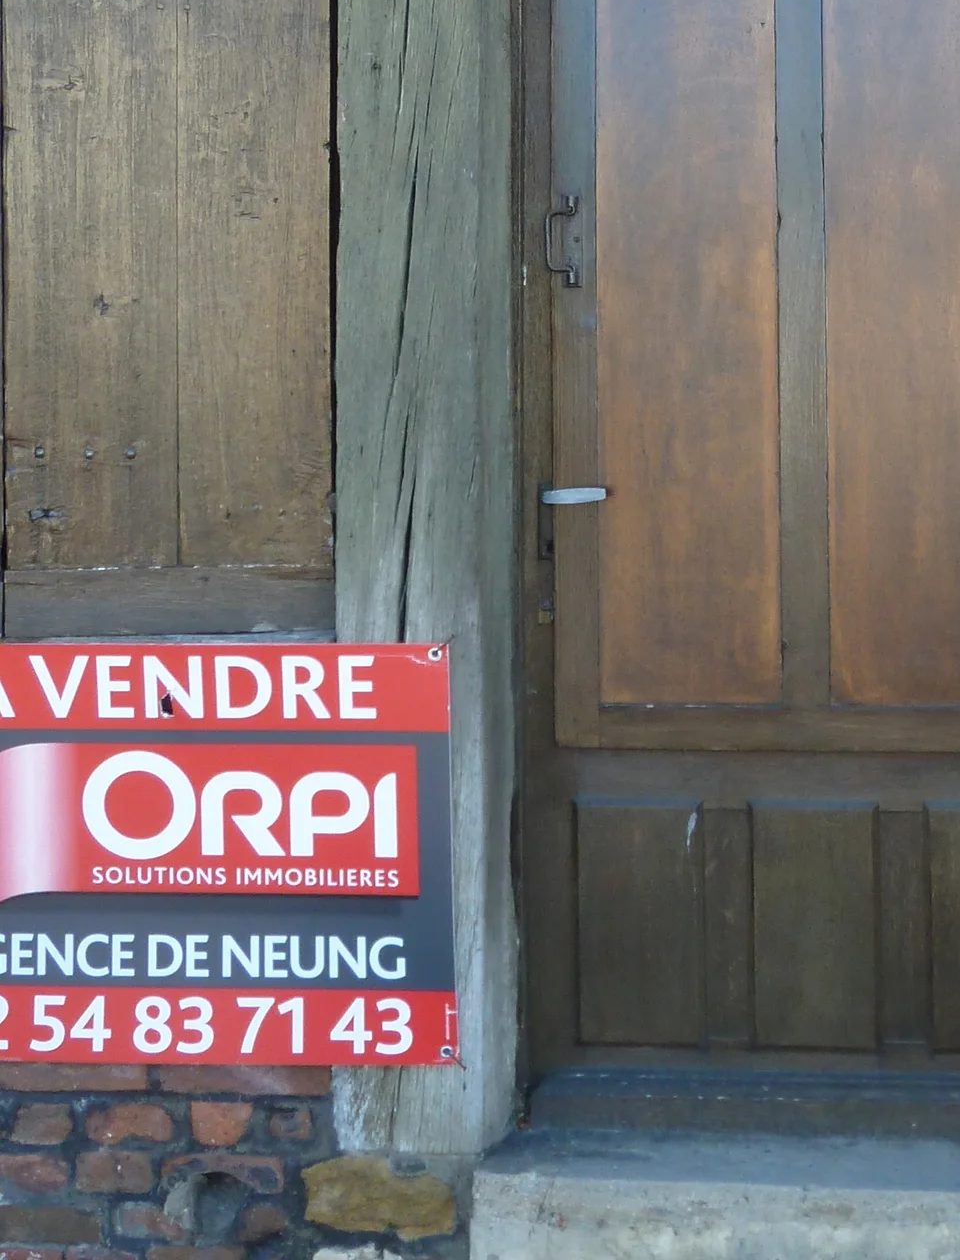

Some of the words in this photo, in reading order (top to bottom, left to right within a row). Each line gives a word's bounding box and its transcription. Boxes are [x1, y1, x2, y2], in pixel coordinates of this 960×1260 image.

[28, 654, 377, 720] VENDRE
[81, 749, 398, 860] ORPI
[92, 866, 227, 886] SOLUTIONS
[235, 867, 399, 888] IMMOBILIERES
[0, 932, 135, 977] ENCE
[147, 934, 210, 978] DE
[221, 934, 407, 980] NEUNG
[29, 994, 112, 1052] 54
[132, 995, 215, 1054] 83
[236, 996, 304, 1054] 71
[329, 997, 414, 1055] 43
